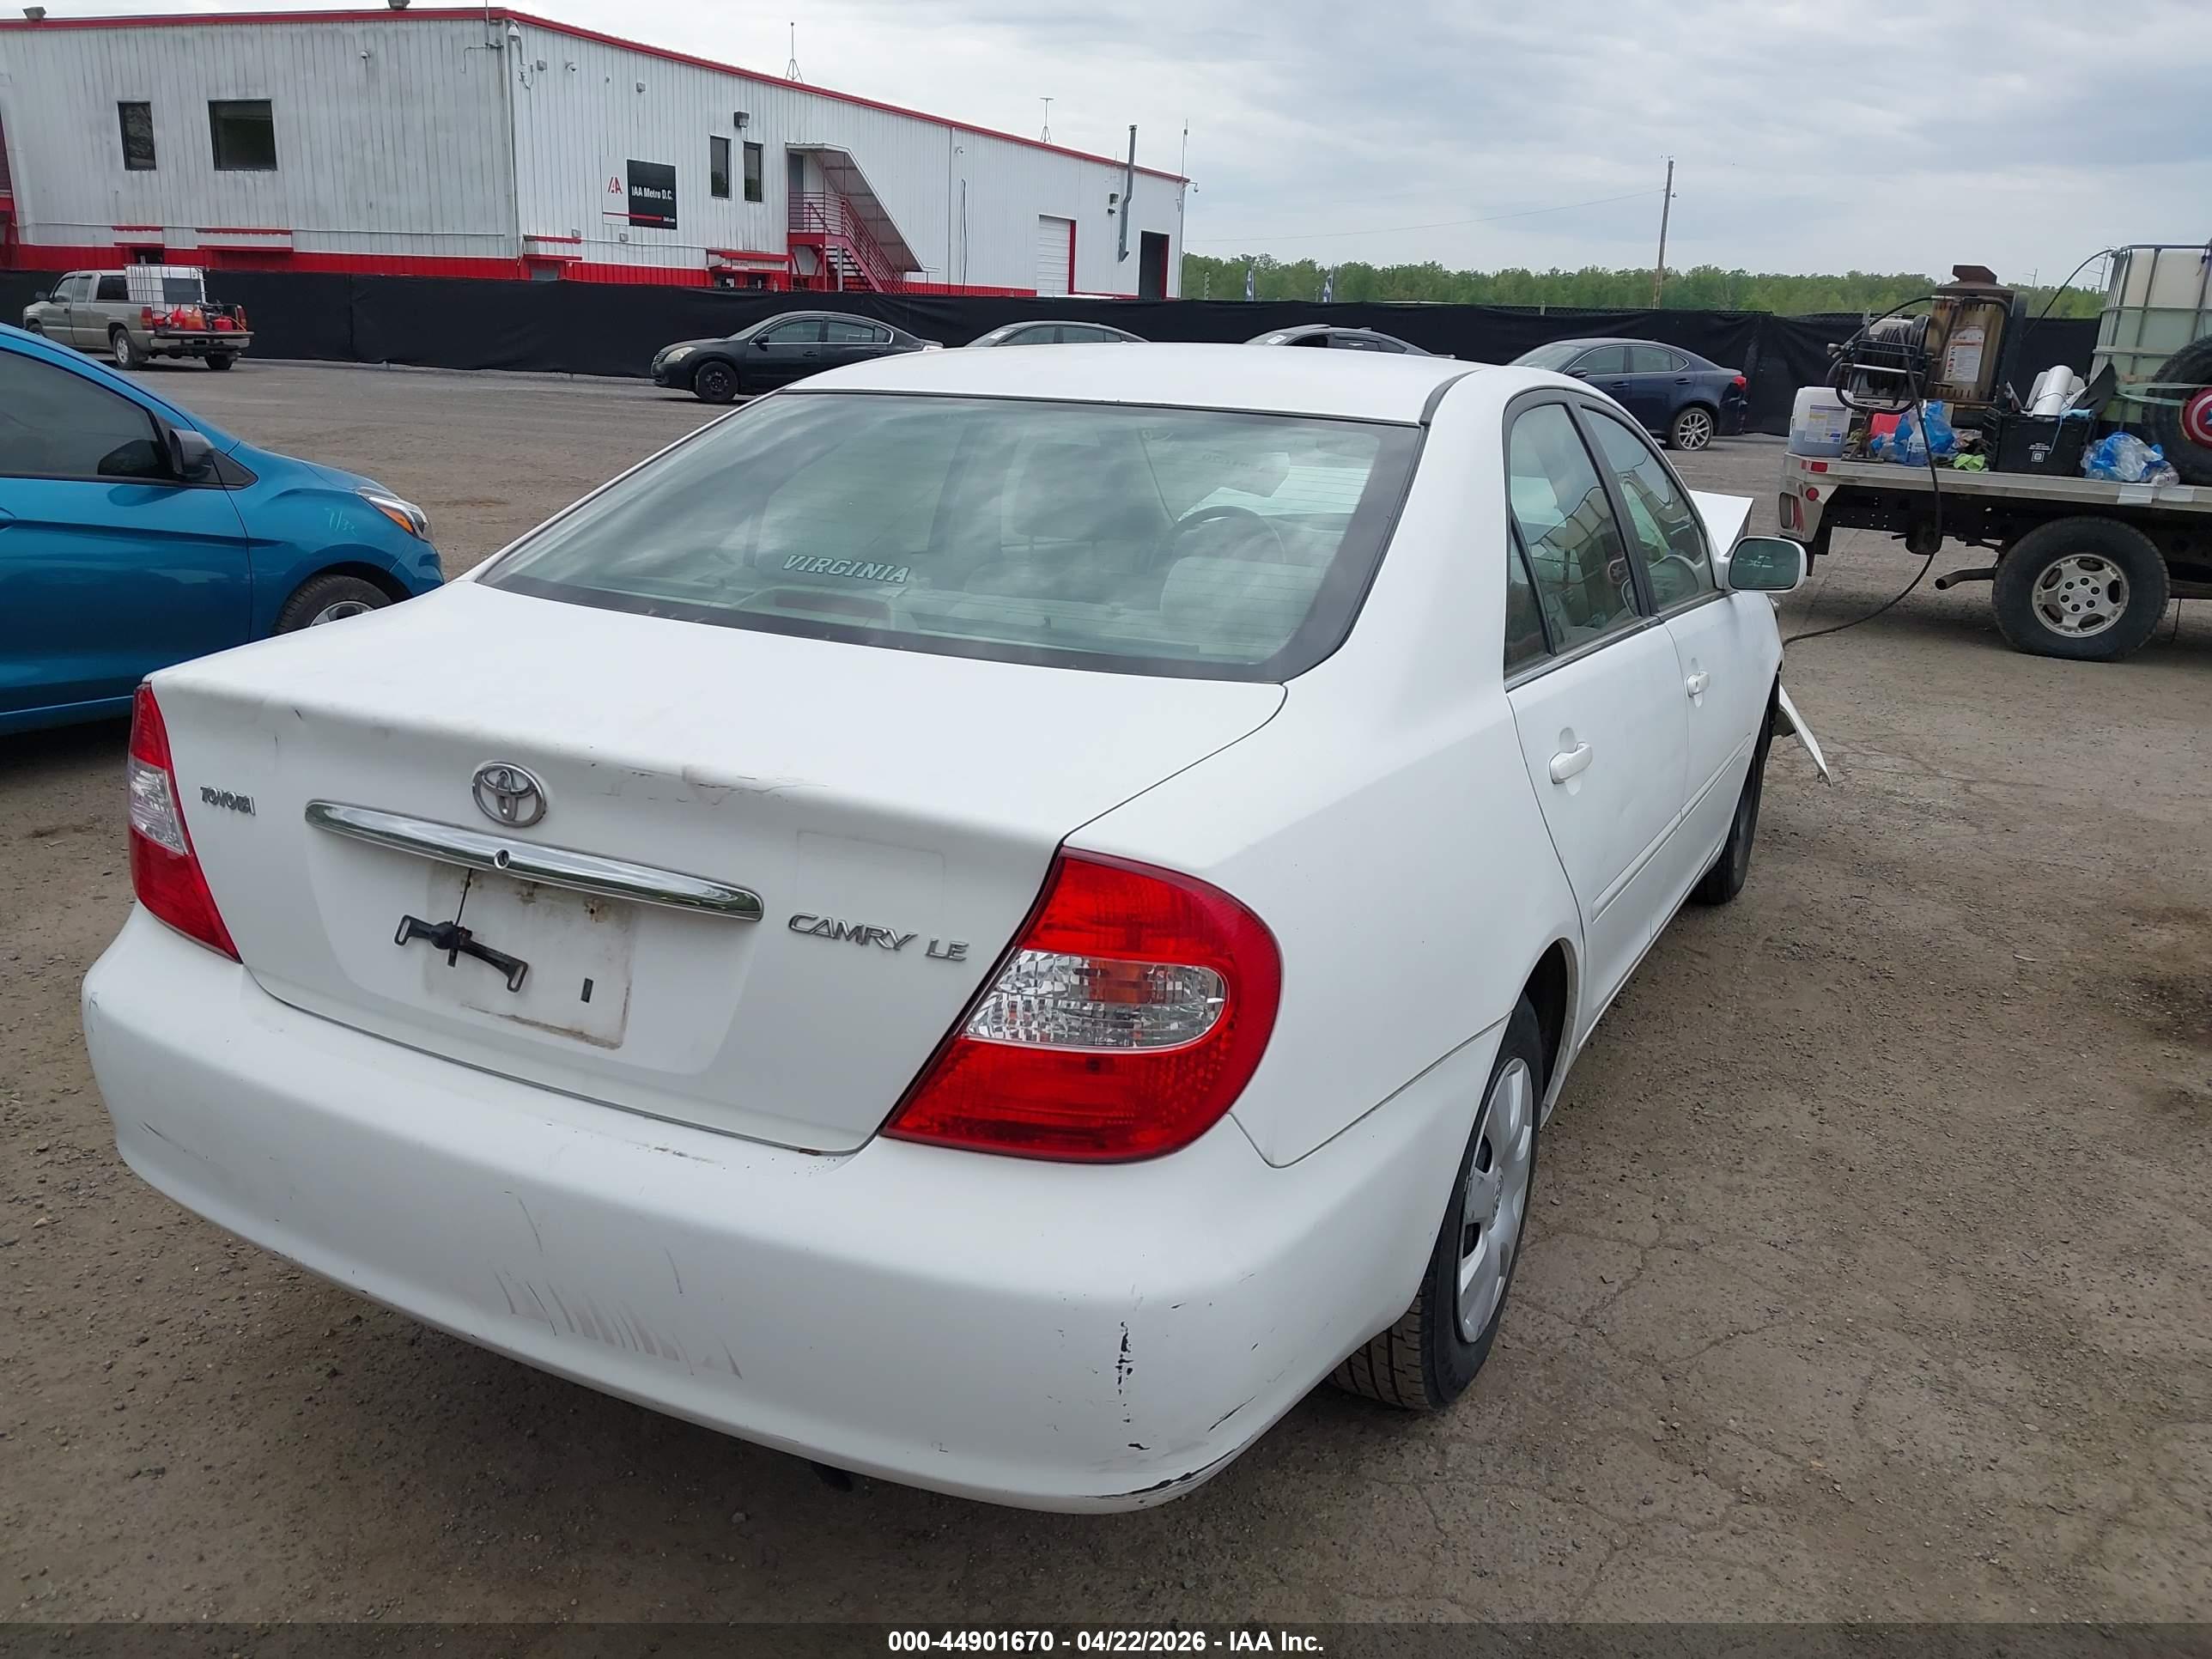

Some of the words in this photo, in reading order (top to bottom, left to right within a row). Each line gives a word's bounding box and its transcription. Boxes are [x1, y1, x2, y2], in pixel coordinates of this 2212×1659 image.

[631, 185, 643, 197] IAA
[643, 186, 661, 198] Metro
[781, 554, 910, 584] VIRGINIA
[199, 784, 256, 817] TOYOTA
[788, 911, 918, 951] CAMRY
[925, 937, 969, 963] LE
